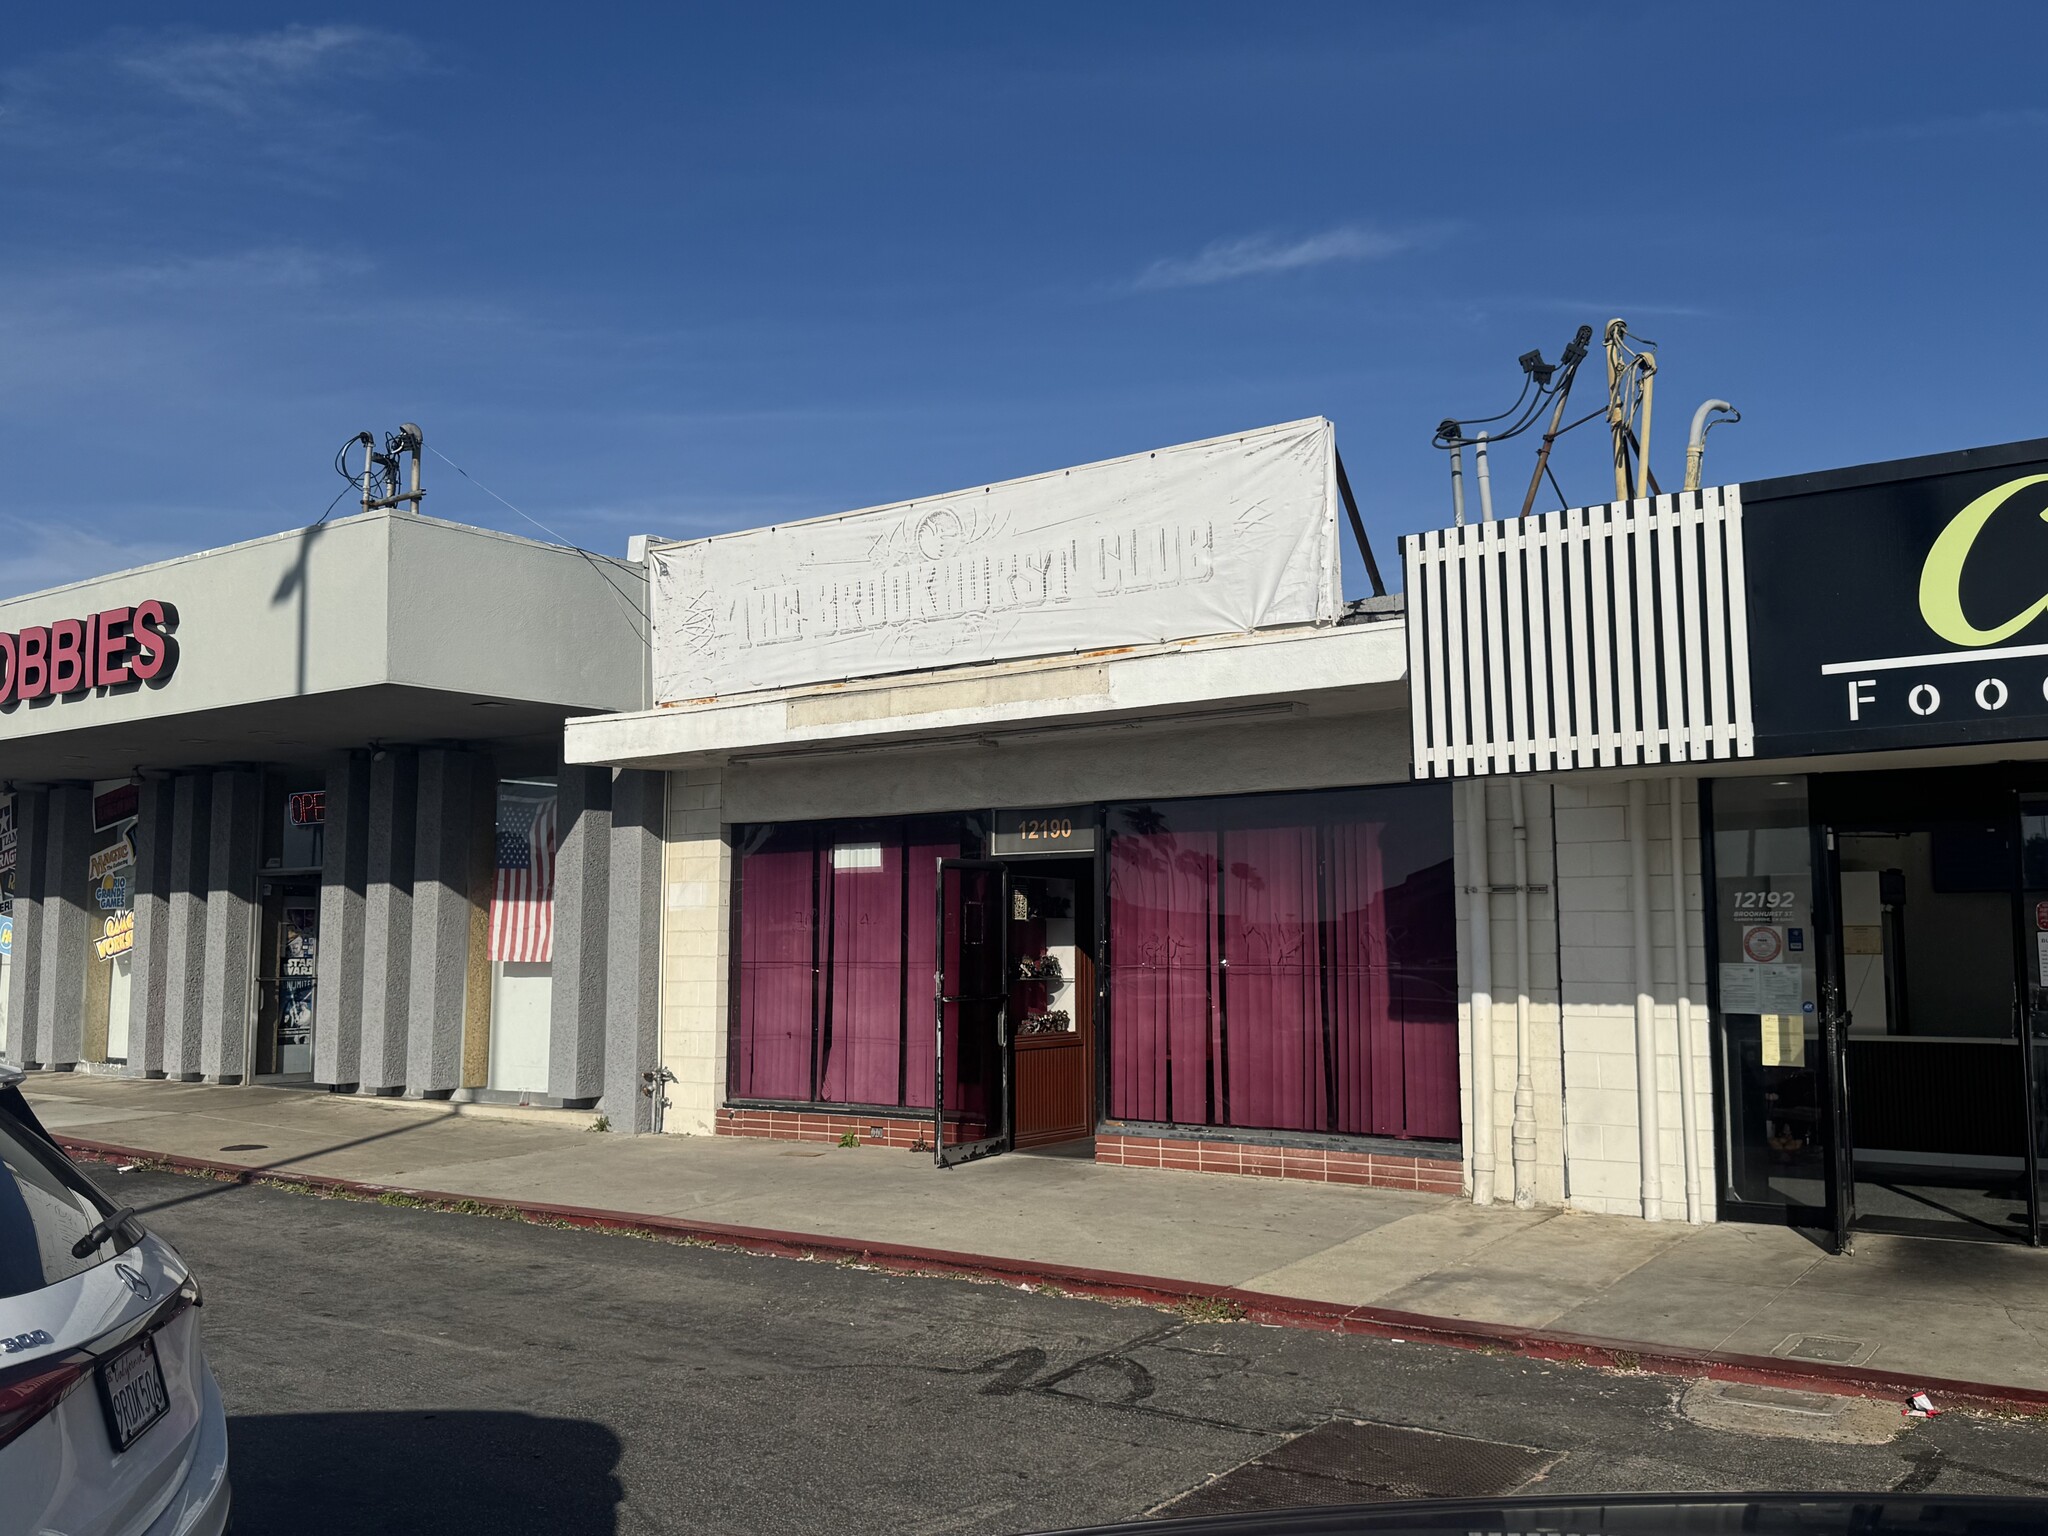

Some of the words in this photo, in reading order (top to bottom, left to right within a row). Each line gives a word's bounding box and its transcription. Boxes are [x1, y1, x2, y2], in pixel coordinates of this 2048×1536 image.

[1918, 473, 2048, 647] C
[1848, 675, 2048, 721] FOO
[1018, 818, 1072, 840] 12190
[90, 844, 129, 879] MAGIC
[96, 887, 126, 899] GRANDE
[113, 877, 126, 888] RIO
[100, 897, 125, 909] GAMES
[1734, 891, 1795, 908] 12192
[106, 911, 135, 937] GAME
[96, 930, 134, 959] WORKS
[287, 958, 313, 967] STAR
[0, 1329, 55, 1354] 300
[112, 1363, 166, 1437] 9RDK506
